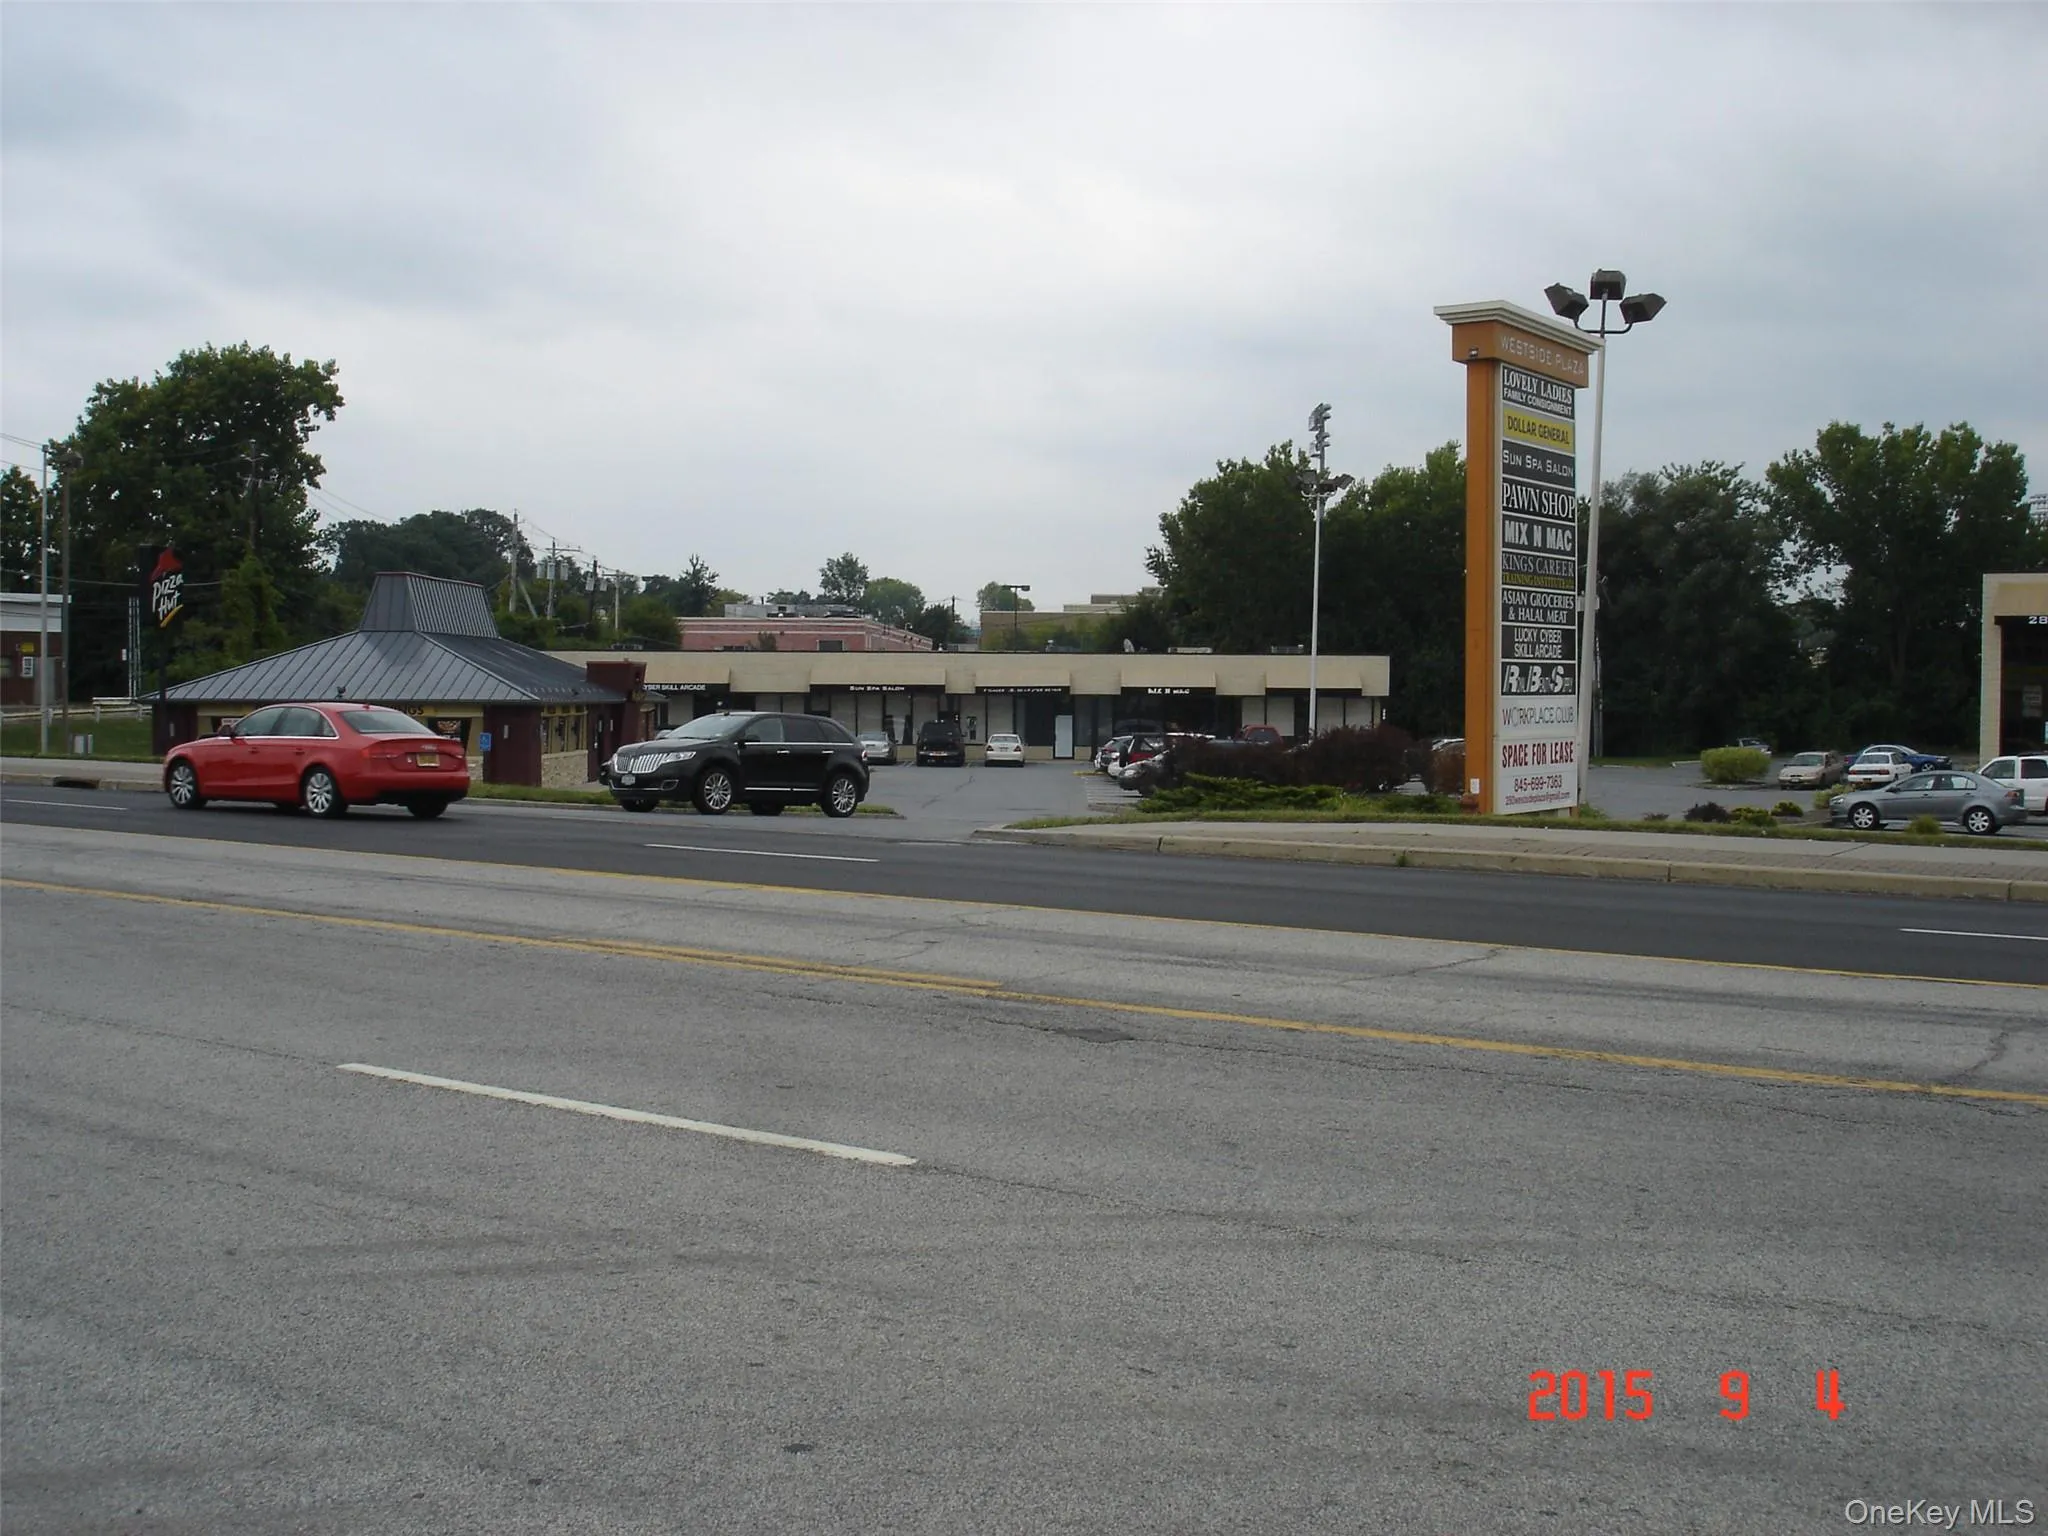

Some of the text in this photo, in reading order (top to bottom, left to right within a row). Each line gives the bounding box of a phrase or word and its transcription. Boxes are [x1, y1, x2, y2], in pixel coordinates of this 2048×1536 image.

[1501, 337, 1584, 376] WESTSIDE PLAZA
[1503, 369, 1572, 405] LOVELY LADIES
[1503, 388, 1572, 416] FAMILY CONSIGNMENT
[1507, 415, 1570, 444] DOLLAR GENERAL
[1503, 482, 1575, 518] PAWN SHOP
[1504, 520, 1572, 551] MIX N MAC
[1502, 553, 1574, 577] KINGS CAREER
[151, 574, 184, 613] Pizza
[157, 590, 182, 621] Hut
[1502, 590, 1574, 609] ASIAN GROCERIES
[1508, 606, 1568, 624] & HALAL MEAT
[1514, 627, 1562, 643] LUCKY CYBER
[1514, 643, 1562, 658] SKILL ARCADE
[1502, 706, 1574, 727] WORKPLACE CLUB
[1502, 741, 1574, 768] SPACE FOR LEASE
